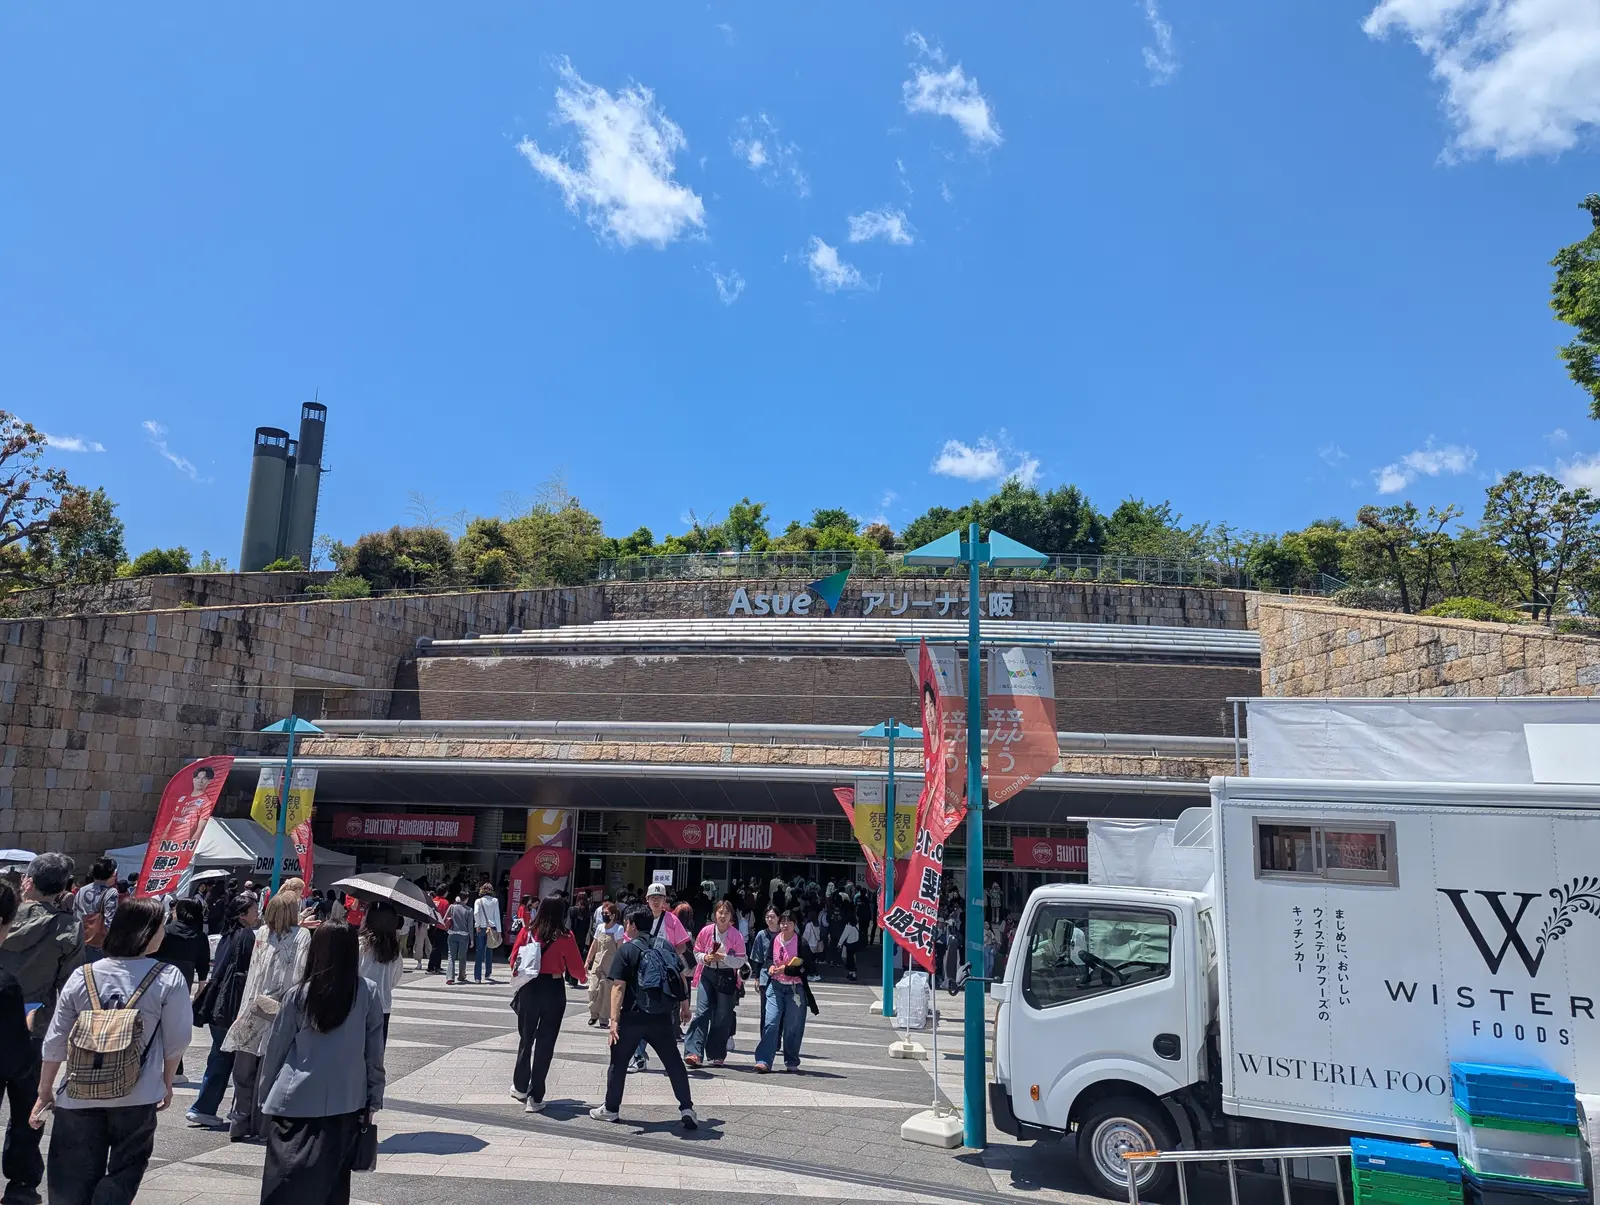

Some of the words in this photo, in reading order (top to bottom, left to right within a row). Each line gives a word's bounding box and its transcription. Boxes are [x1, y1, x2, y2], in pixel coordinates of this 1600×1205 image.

[728, 587, 812, 615] Asue
[862, 591, 1014, 617] アリーナ大阪
[994, 773, 1031, 798] Compete
[264, 794, 279, 821] 観る
[287, 795, 301, 821] 観る
[364, 818, 397, 834] SUNTORY
[398, 820, 434, 837] SUNBIRDS
[434, 821, 460, 837] OSAKA
[705, 823, 736, 848] PLAY
[739, 824, 773, 850] HARD
[869, 811, 887, 842] 観る
[894, 812, 911, 843] 観る
[159, 839, 197, 852] No.11
[283, 858, 301, 872] SHO
[1292, 906, 1305, 973] キッチンカー
[1313, 907, 1330, 1021] ウイステリアフーズの
[1335, 909, 1351, 1006] まじめに、おいしい
[1384, 980, 1595, 1020] WISTER
[1472, 1020, 1570, 1046] FOODS
[1237, 1052, 1380, 1089] WISTERIA
[1384, 1069, 1452, 1097] FOO
